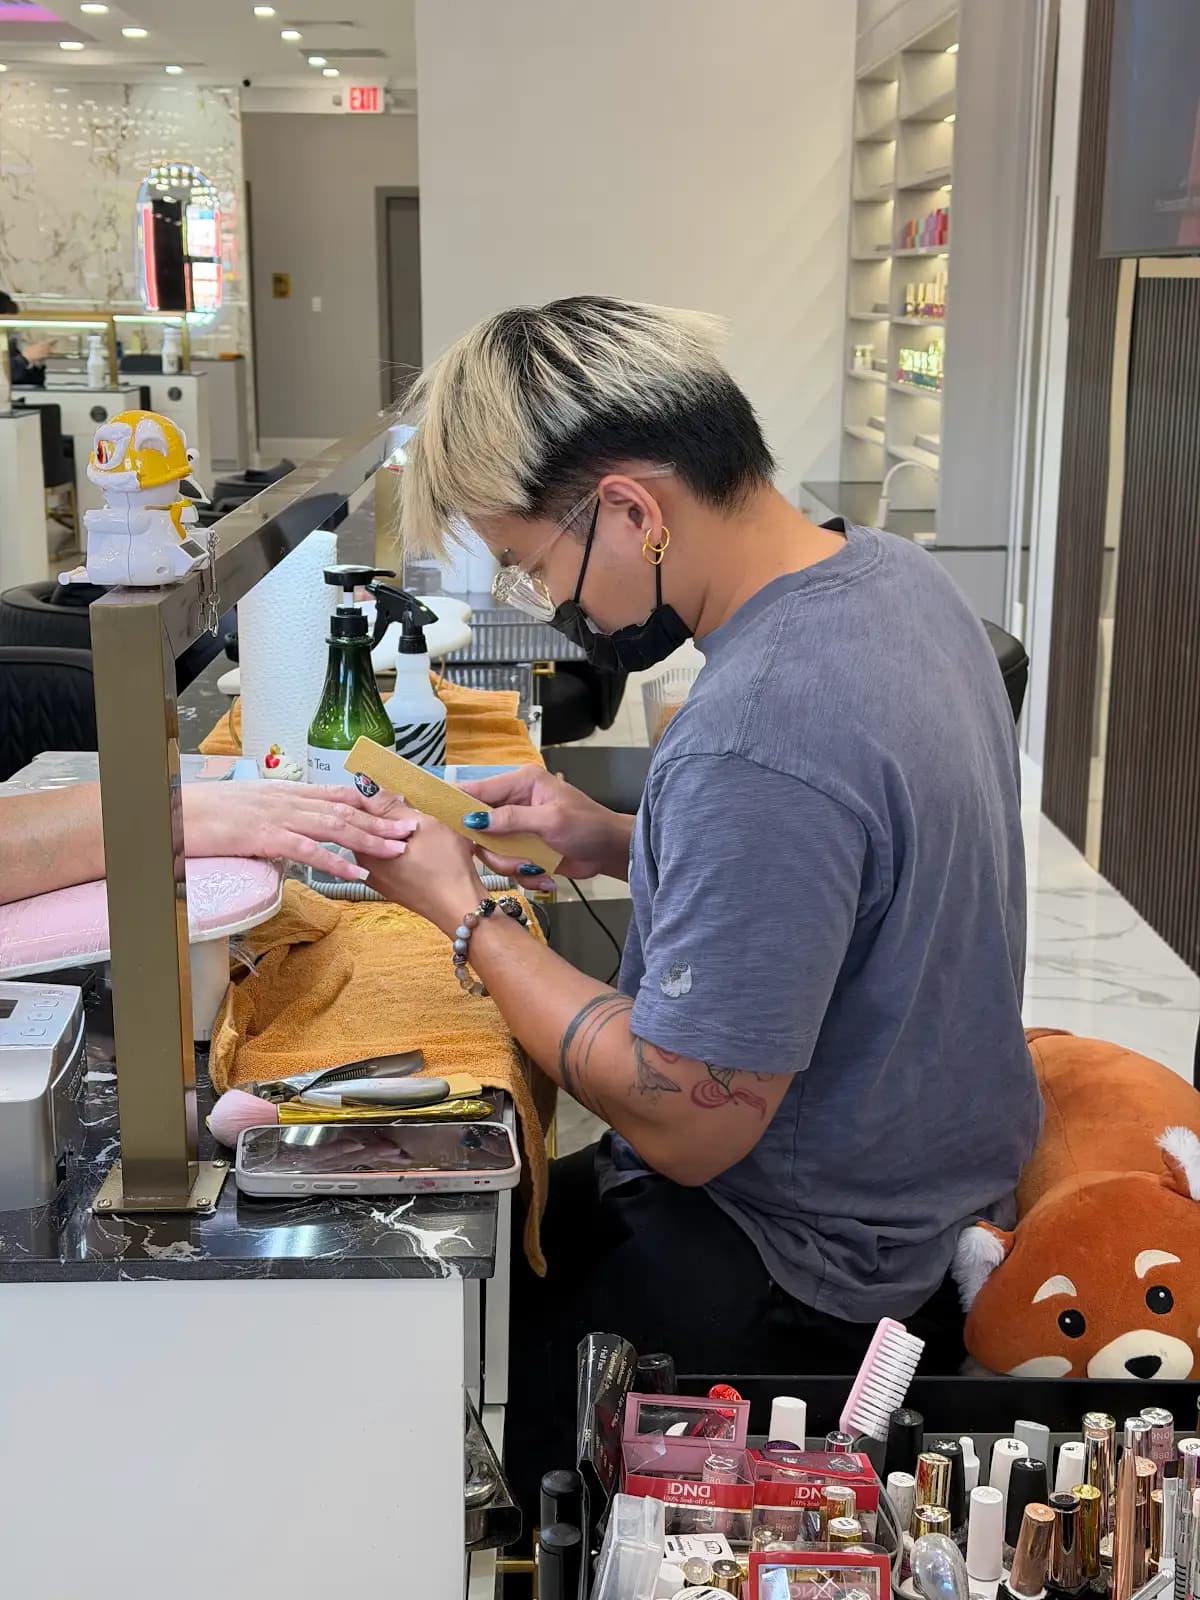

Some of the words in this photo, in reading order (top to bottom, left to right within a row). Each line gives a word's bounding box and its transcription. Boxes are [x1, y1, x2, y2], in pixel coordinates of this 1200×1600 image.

[351, 86, 379, 111] EXIT
[314, 758, 331, 771] Tea
[670, 1482, 711, 1498] DND
[798, 1486, 822, 1500] DN
